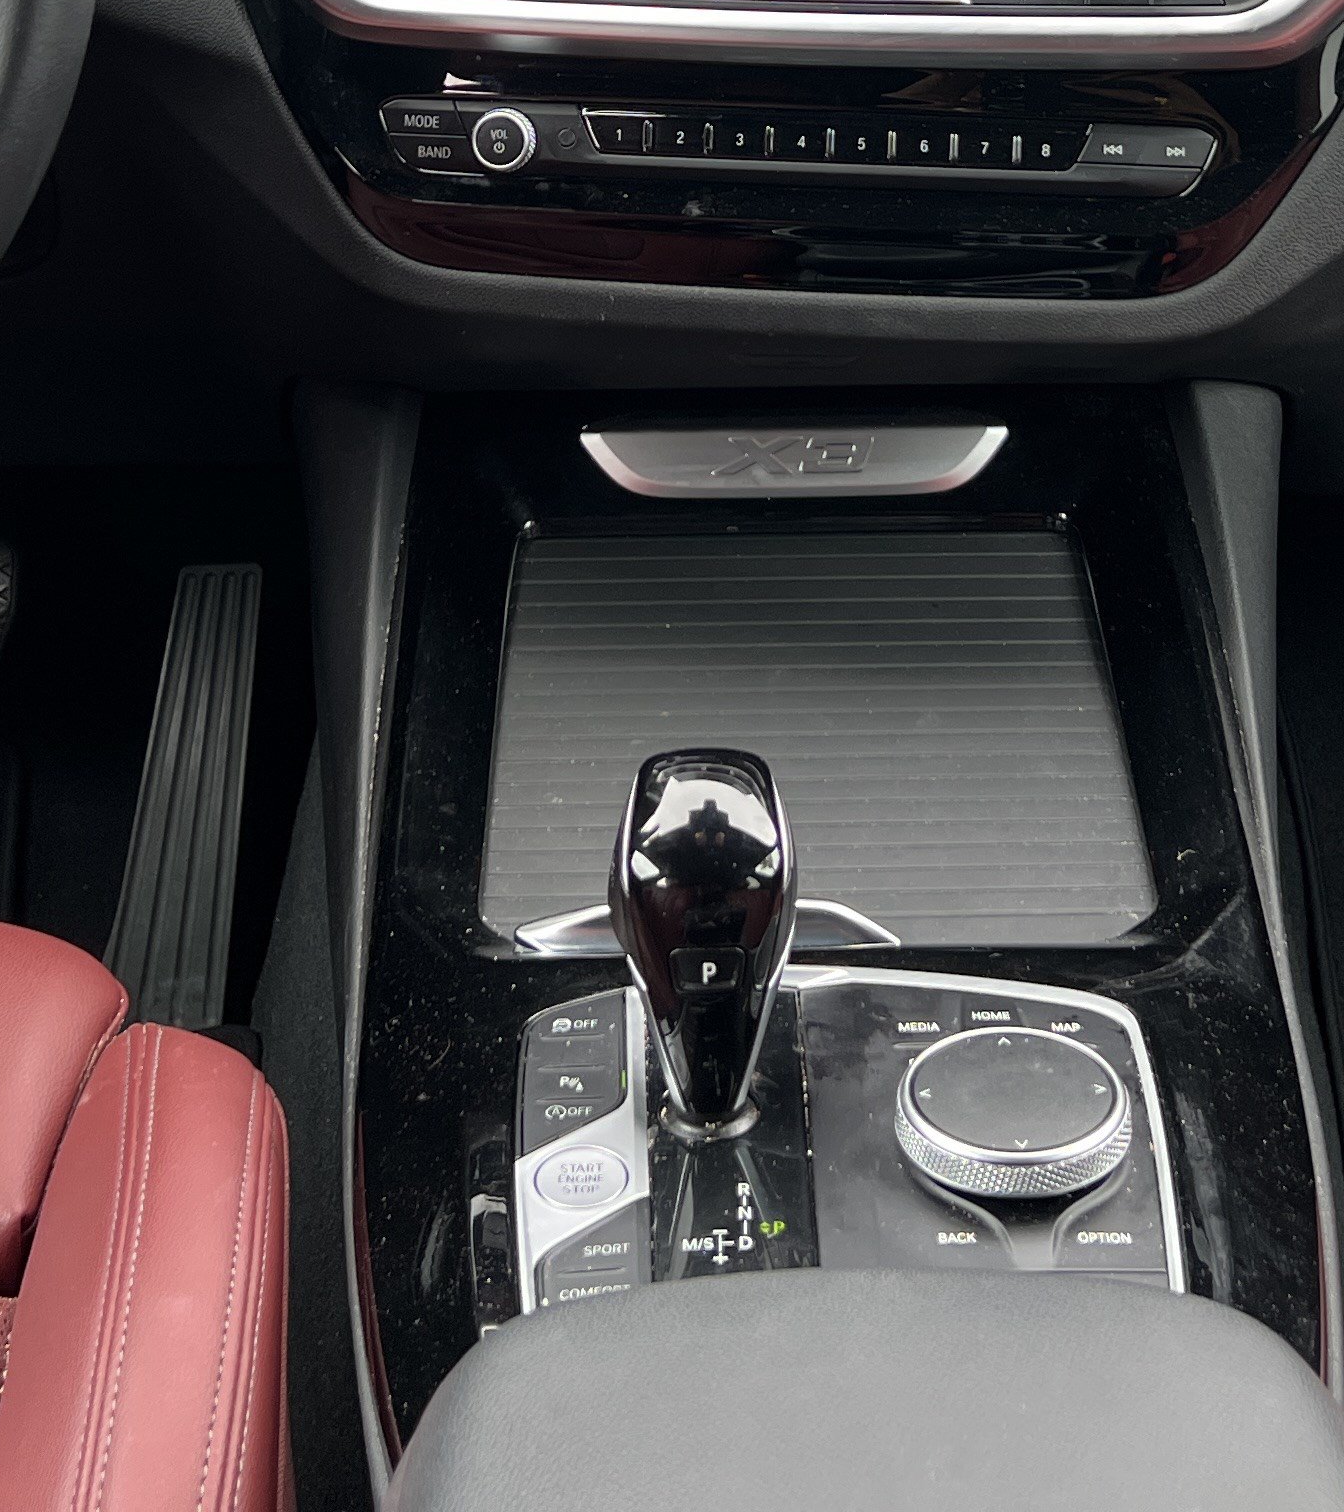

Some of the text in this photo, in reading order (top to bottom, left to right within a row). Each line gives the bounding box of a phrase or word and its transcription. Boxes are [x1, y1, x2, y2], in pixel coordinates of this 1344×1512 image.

[404, 115, 440, 129] MODE
[490, 129, 507, 141] VOL
[616, 129, 622, 141] 1
[676, 131, 684, 144] 2
[735, 133, 744, 146] 3
[797, 135, 806, 148] 4
[857, 137, 866, 151] 5
[920, 139, 929, 153] 6
[980, 141, 989, 155] 7
[1041, 144, 1051, 157] 8
[418, 145, 451, 160] BAND
[702, 962, 716, 985] P
[971, 1010, 1010, 1022] HOME
[574, 1018, 598, 1029] OFF
[898, 1021, 940, 1033] MEDIA
[1051, 1022, 1081, 1033] MAP
[568, 1106, 593, 1117] OFF
[560, 1162, 603, 1174] START
[558, 1173, 604, 1184] ENGINE
[562, 1184, 600, 1195] STOP
[738, 1183, 750, 1197] R
[738, 1206, 752, 1221] N
[682, 1237, 714, 1252] M/S
[739, 1236, 753, 1251] D
[938, 1232, 977, 1244] BACK
[1077, 1231, 1133, 1245] OPTION
[583, 1243, 630, 1257] SPORT
